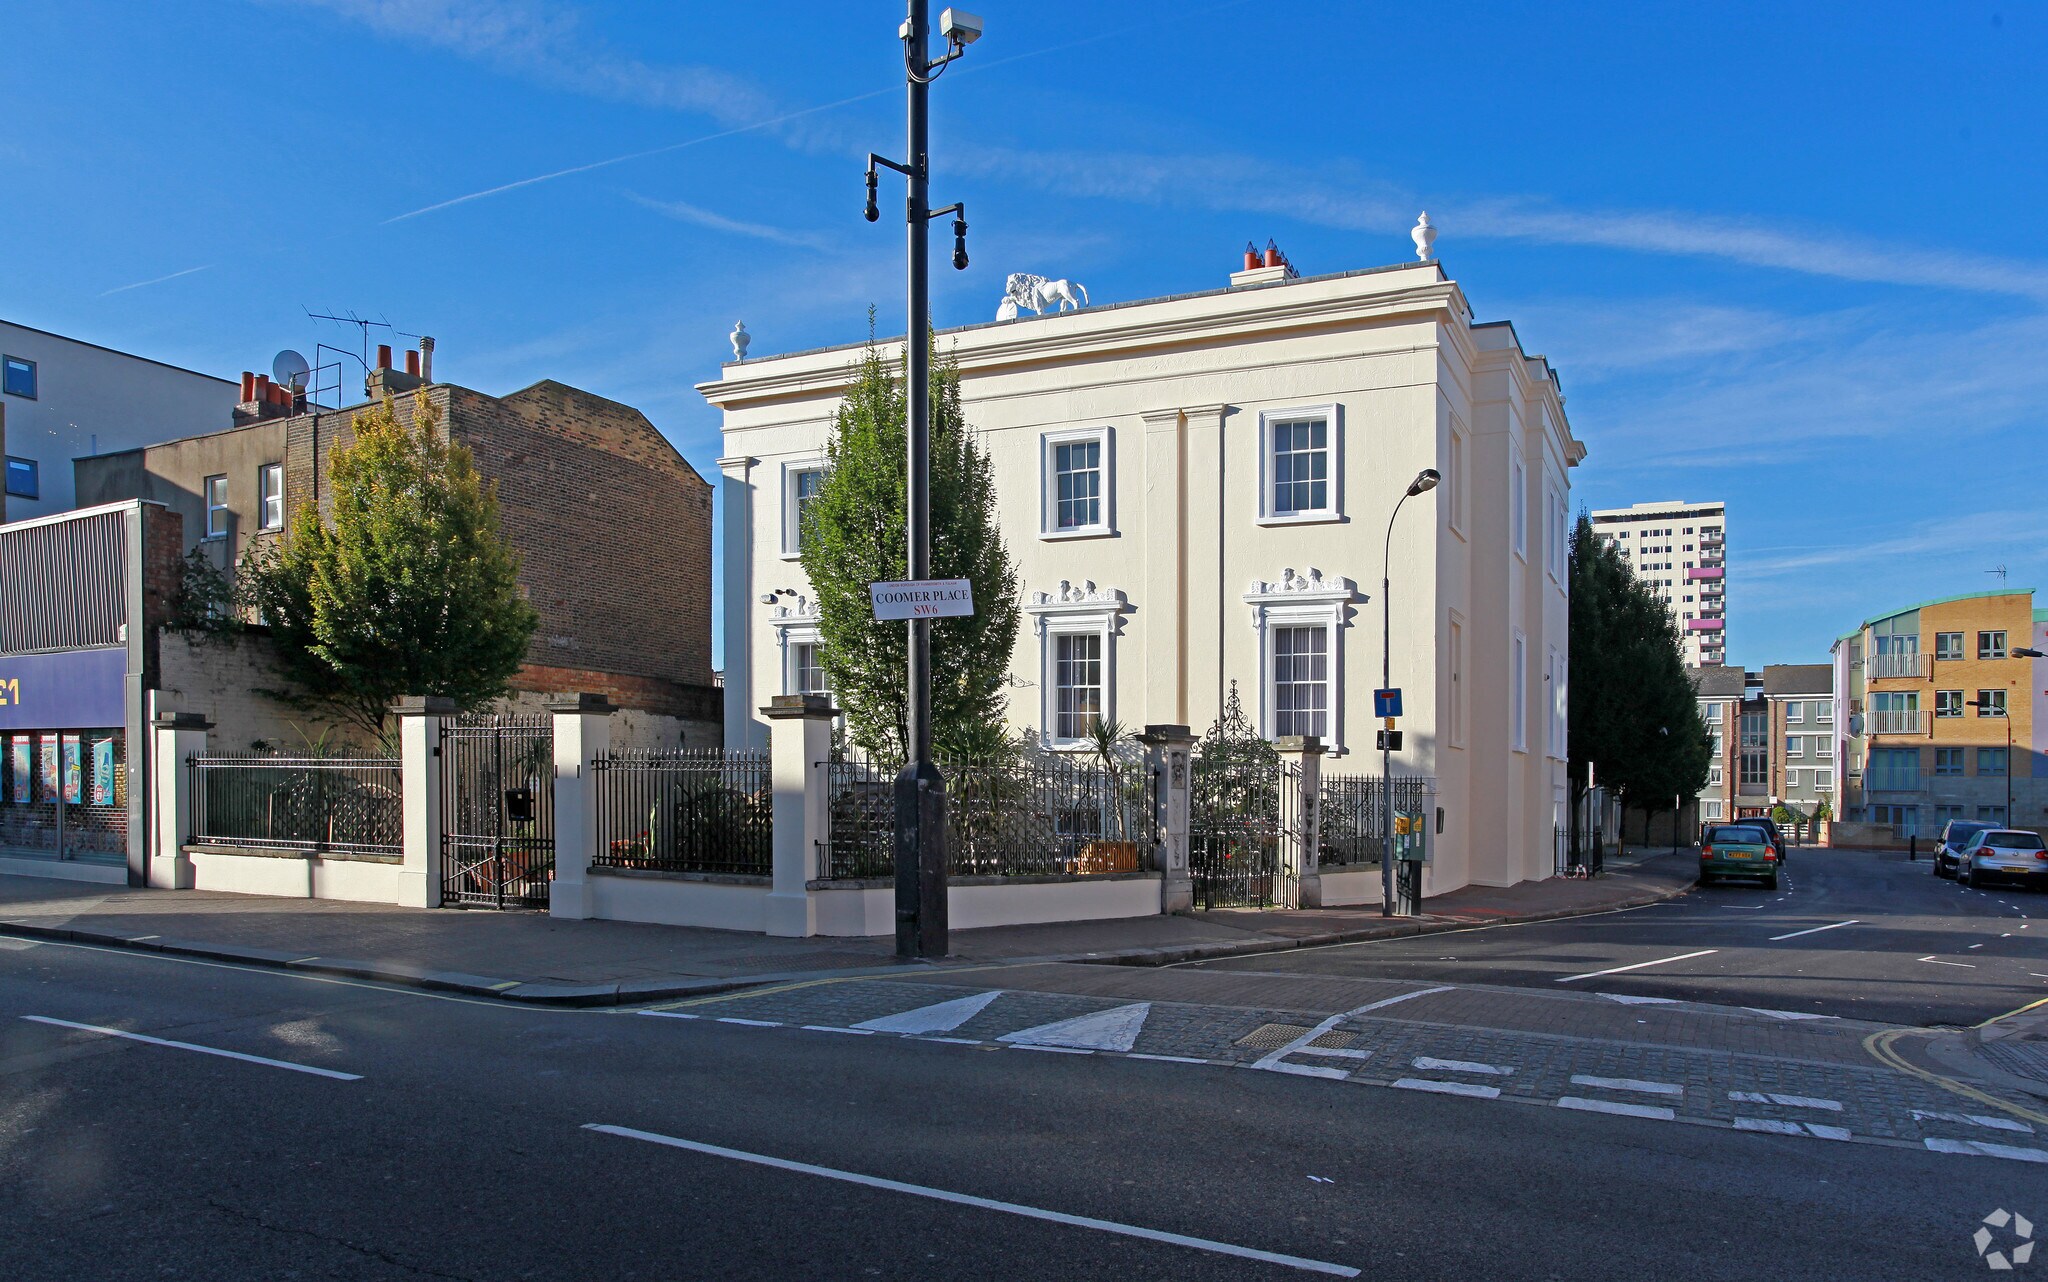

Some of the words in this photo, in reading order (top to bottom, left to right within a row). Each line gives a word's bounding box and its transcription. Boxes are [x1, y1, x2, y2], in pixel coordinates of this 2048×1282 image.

[876, 592, 930, 604] COOMER
[933, 589, 969, 600] PLACE
[914, 605, 938, 615] SW6
